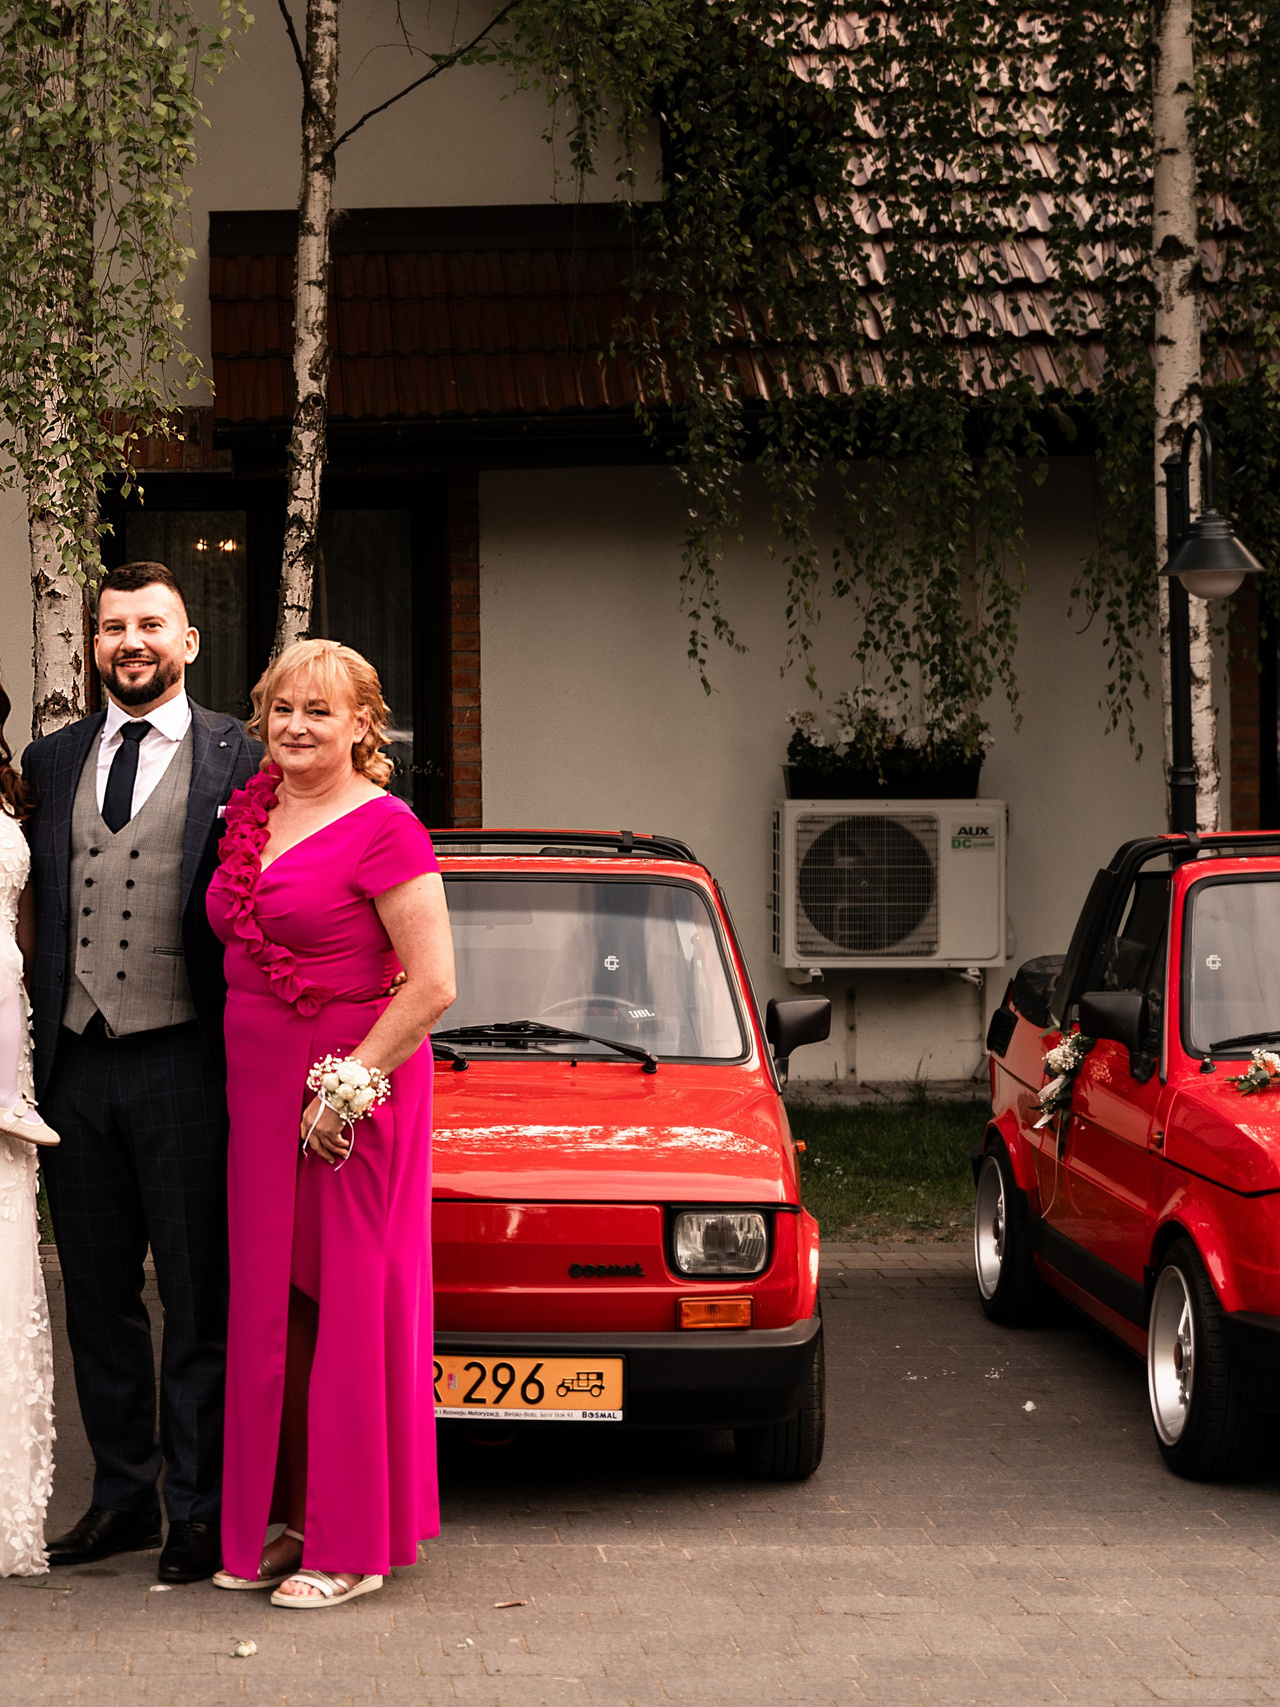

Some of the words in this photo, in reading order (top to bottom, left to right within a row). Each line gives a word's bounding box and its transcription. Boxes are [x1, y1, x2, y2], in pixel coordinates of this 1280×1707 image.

[957, 826, 990, 836] AUX
[951, 838, 972, 849] DC
[628, 1008, 656, 1019] JBL
[463, 1361, 545, 1405] 296
[581, 1411, 617, 1419] BOSMAL
